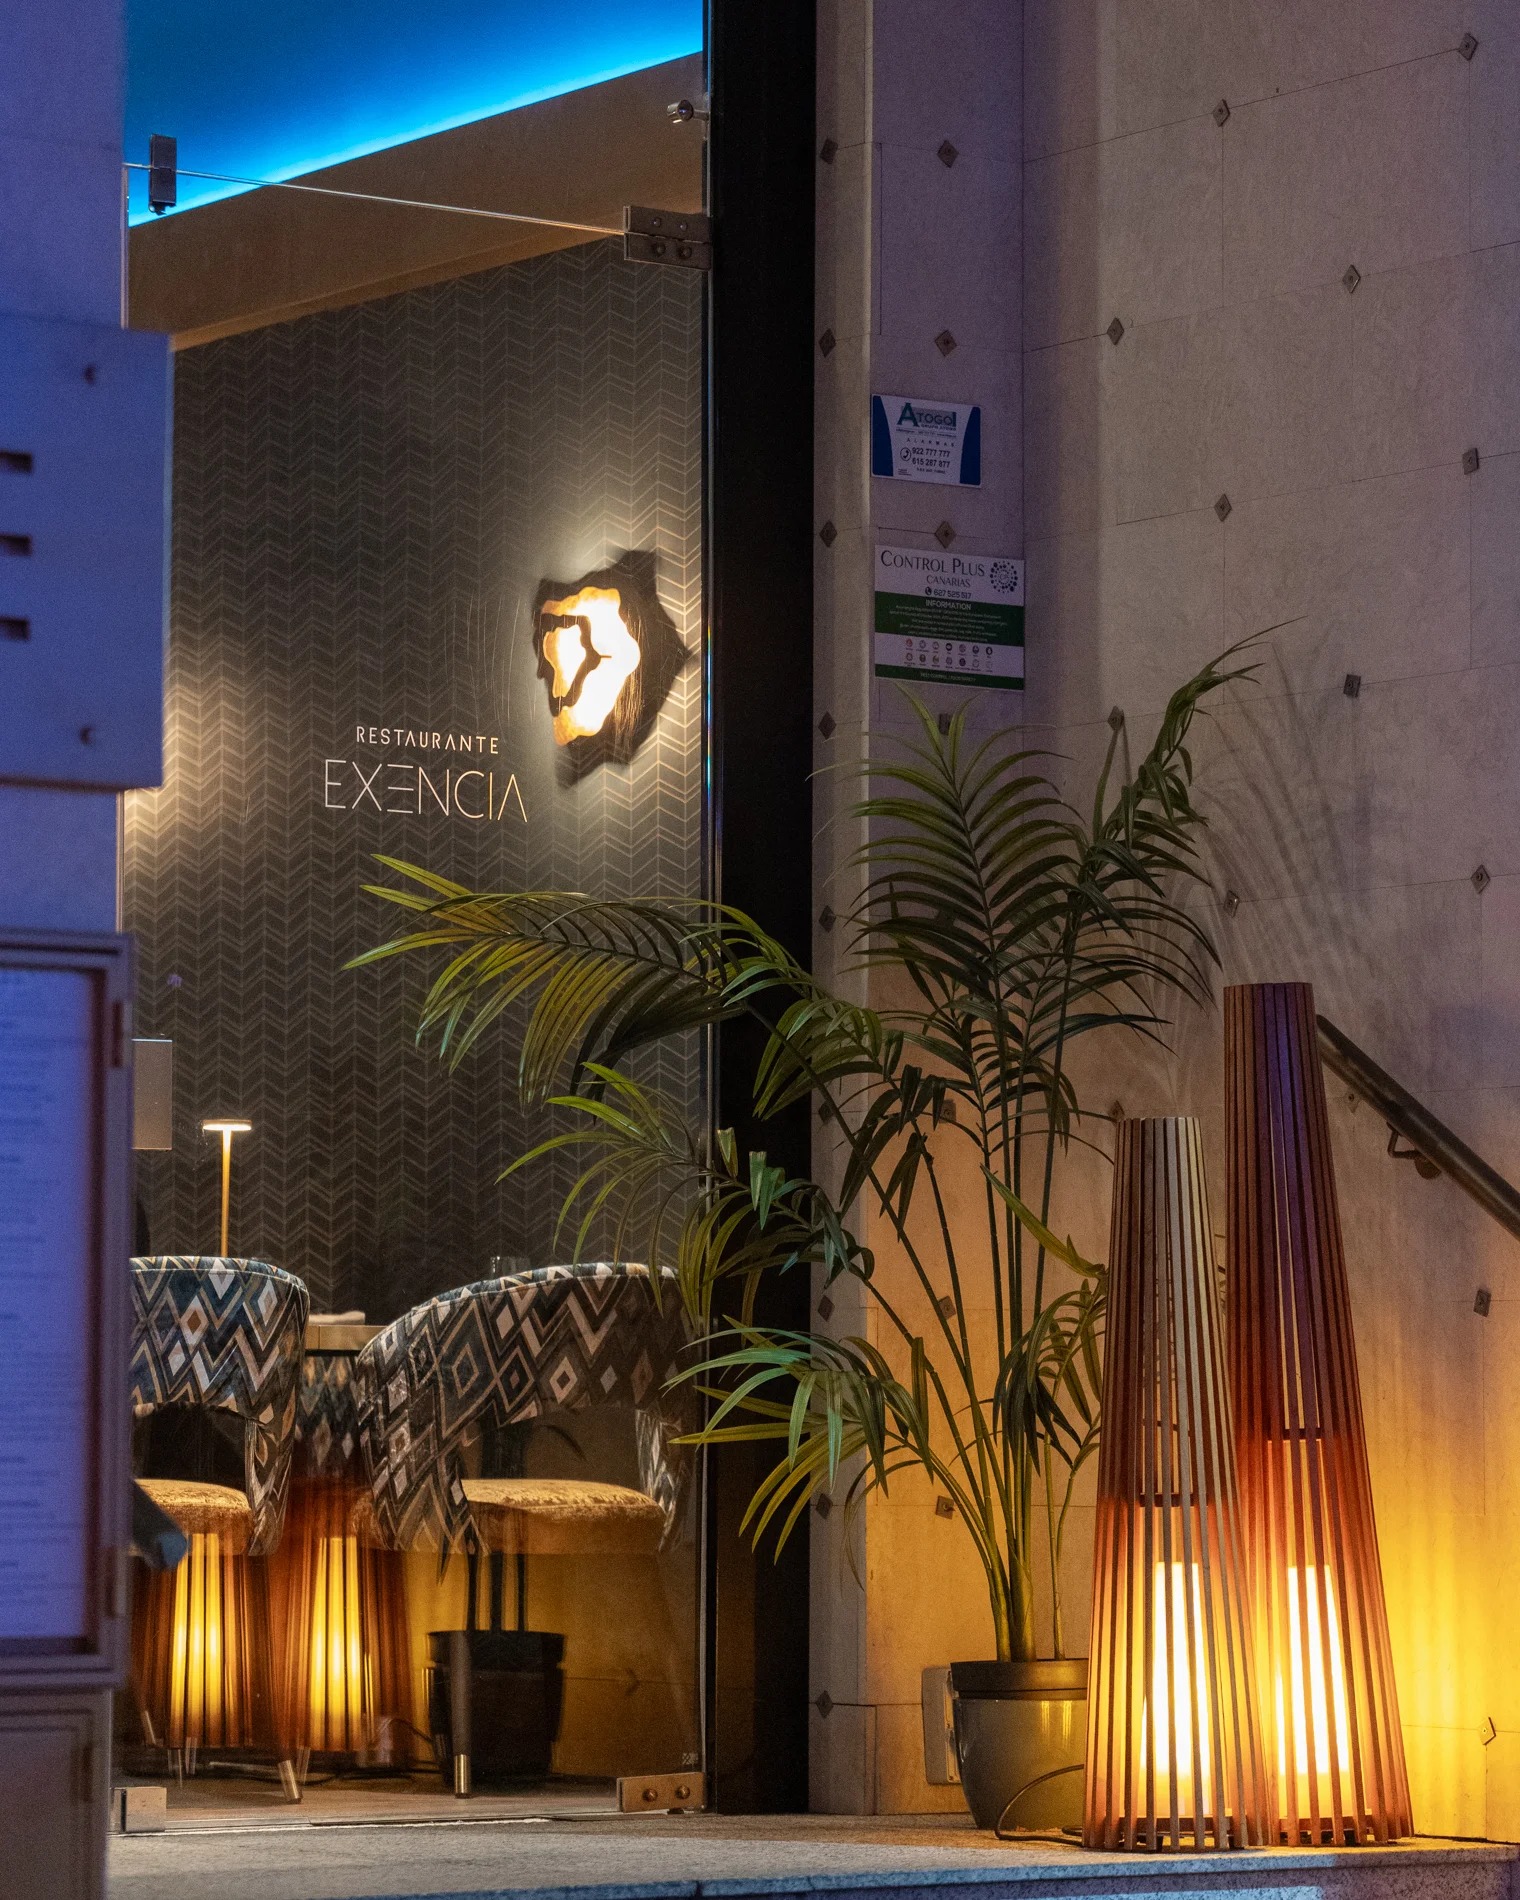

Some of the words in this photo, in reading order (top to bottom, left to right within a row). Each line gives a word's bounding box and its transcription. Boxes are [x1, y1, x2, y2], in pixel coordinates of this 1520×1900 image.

[912, 447, 924, 455] 922
[939, 450, 950, 458] 777
[881, 550, 948, 573] CONTROL
[952, 558, 985, 577] PLUS
[926, 575, 971, 588] CANARIAS
[934, 588, 946, 596] 627
[947, 589, 960, 598] 525
[961, 591, 972, 599] 517
[925, 599, 971, 610] INFORMATION
[356, 726, 499, 754] RESTAURANTE
[325, 759, 527, 823] EXENCIA
